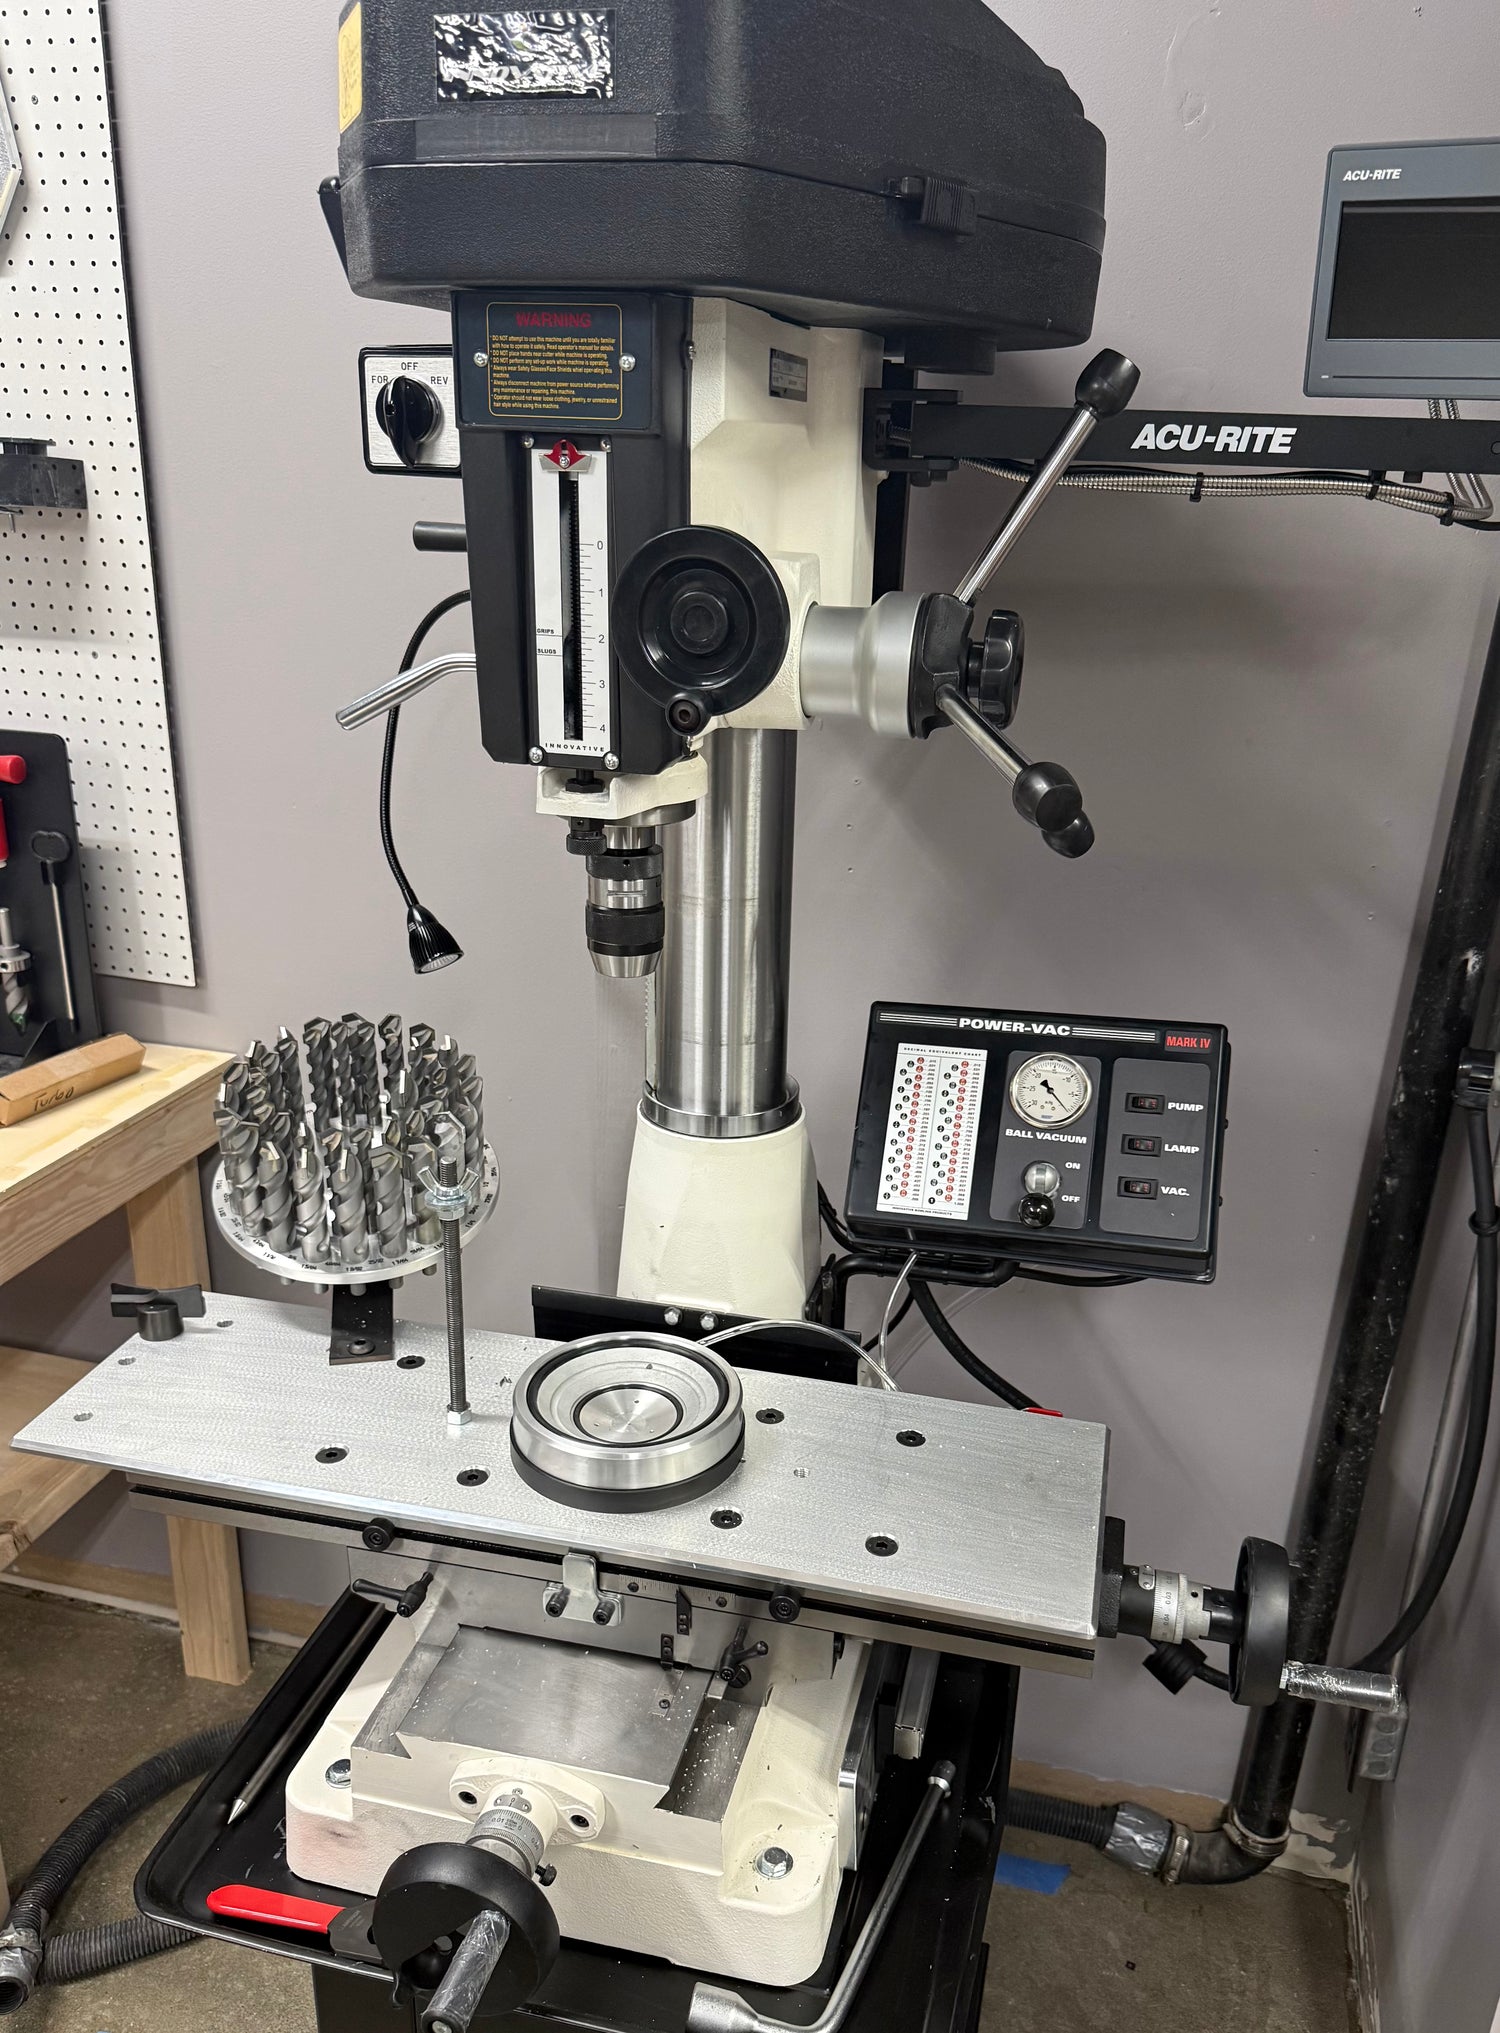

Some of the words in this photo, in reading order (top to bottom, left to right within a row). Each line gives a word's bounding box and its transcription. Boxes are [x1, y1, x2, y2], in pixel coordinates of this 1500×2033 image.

[1342, 168, 1402, 182] ACU-RITE
[515, 312, 592, 328] WARNING
[400, 362, 419, 371] OFF
[372, 376, 388, 384] FOR
[430, 376, 448, 385] REV
[1130, 423, 1298, 454] ACU-RITE
[596, 540, 604, 550] 0
[598, 588, 604, 597] 1
[598, 634, 605, 644] 2
[599, 680, 606, 688] 3
[599, 724, 606, 733] 4
[545, 742, 605, 752] INNOVATIVE
[959, 1018, 1071, 1036] POWER-VAC
[1166, 1035, 1197, 1049] MARK
[1199, 1038, 1212, 1050] IV
[1167, 1102, 1204, 1112] PUMP
[1005, 1128, 1033, 1139] BALL
[1036, 1132, 1087, 1144] VACUUM
[1164, 1144, 1200, 1155] LAMP
[1065, 1161, 1081, 1170] ON
[1161, 1186, 1190, 1197] VAC.
[1062, 1194, 1080, 1204] OFF
